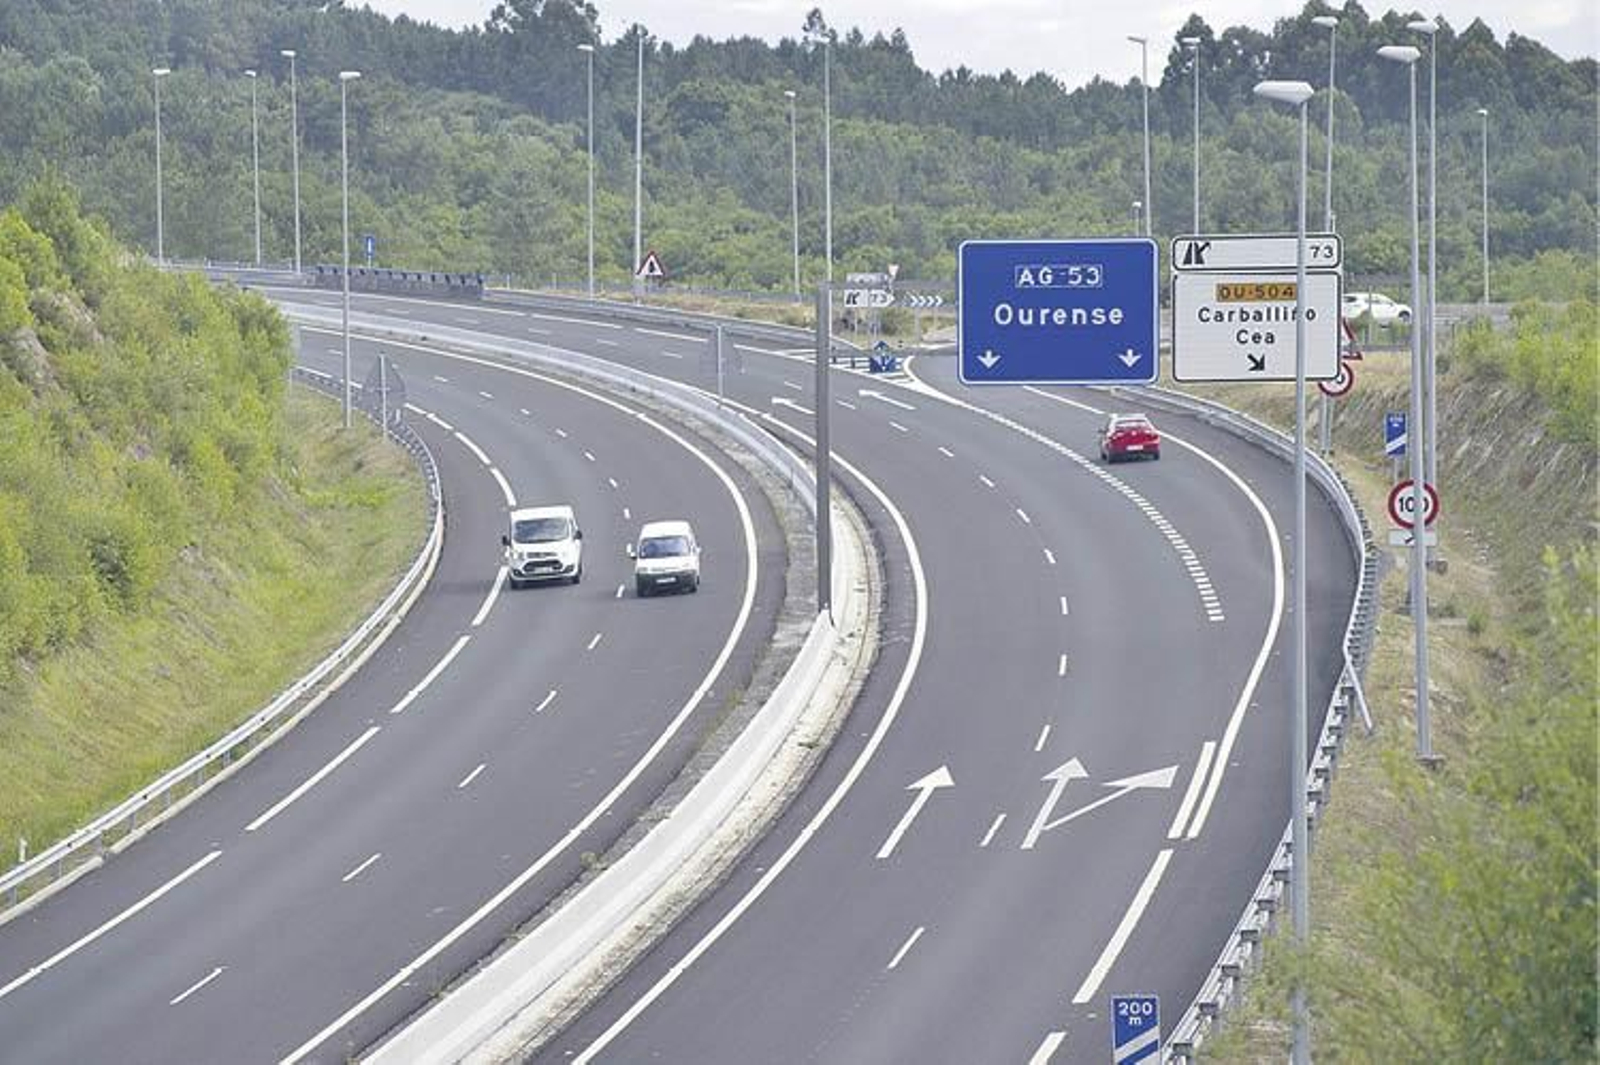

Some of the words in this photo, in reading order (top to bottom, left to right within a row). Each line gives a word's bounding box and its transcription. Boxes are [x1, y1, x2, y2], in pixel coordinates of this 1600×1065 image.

[1310, 245, 1334, 258] 73
[1019, 266, 1100, 286] AG-53
[994, 304, 1124, 325] Ourense
[1236, 329, 1275, 344] Cea
[1119, 1002, 1153, 1016] 200
[1129, 1016, 1142, 1025] m
